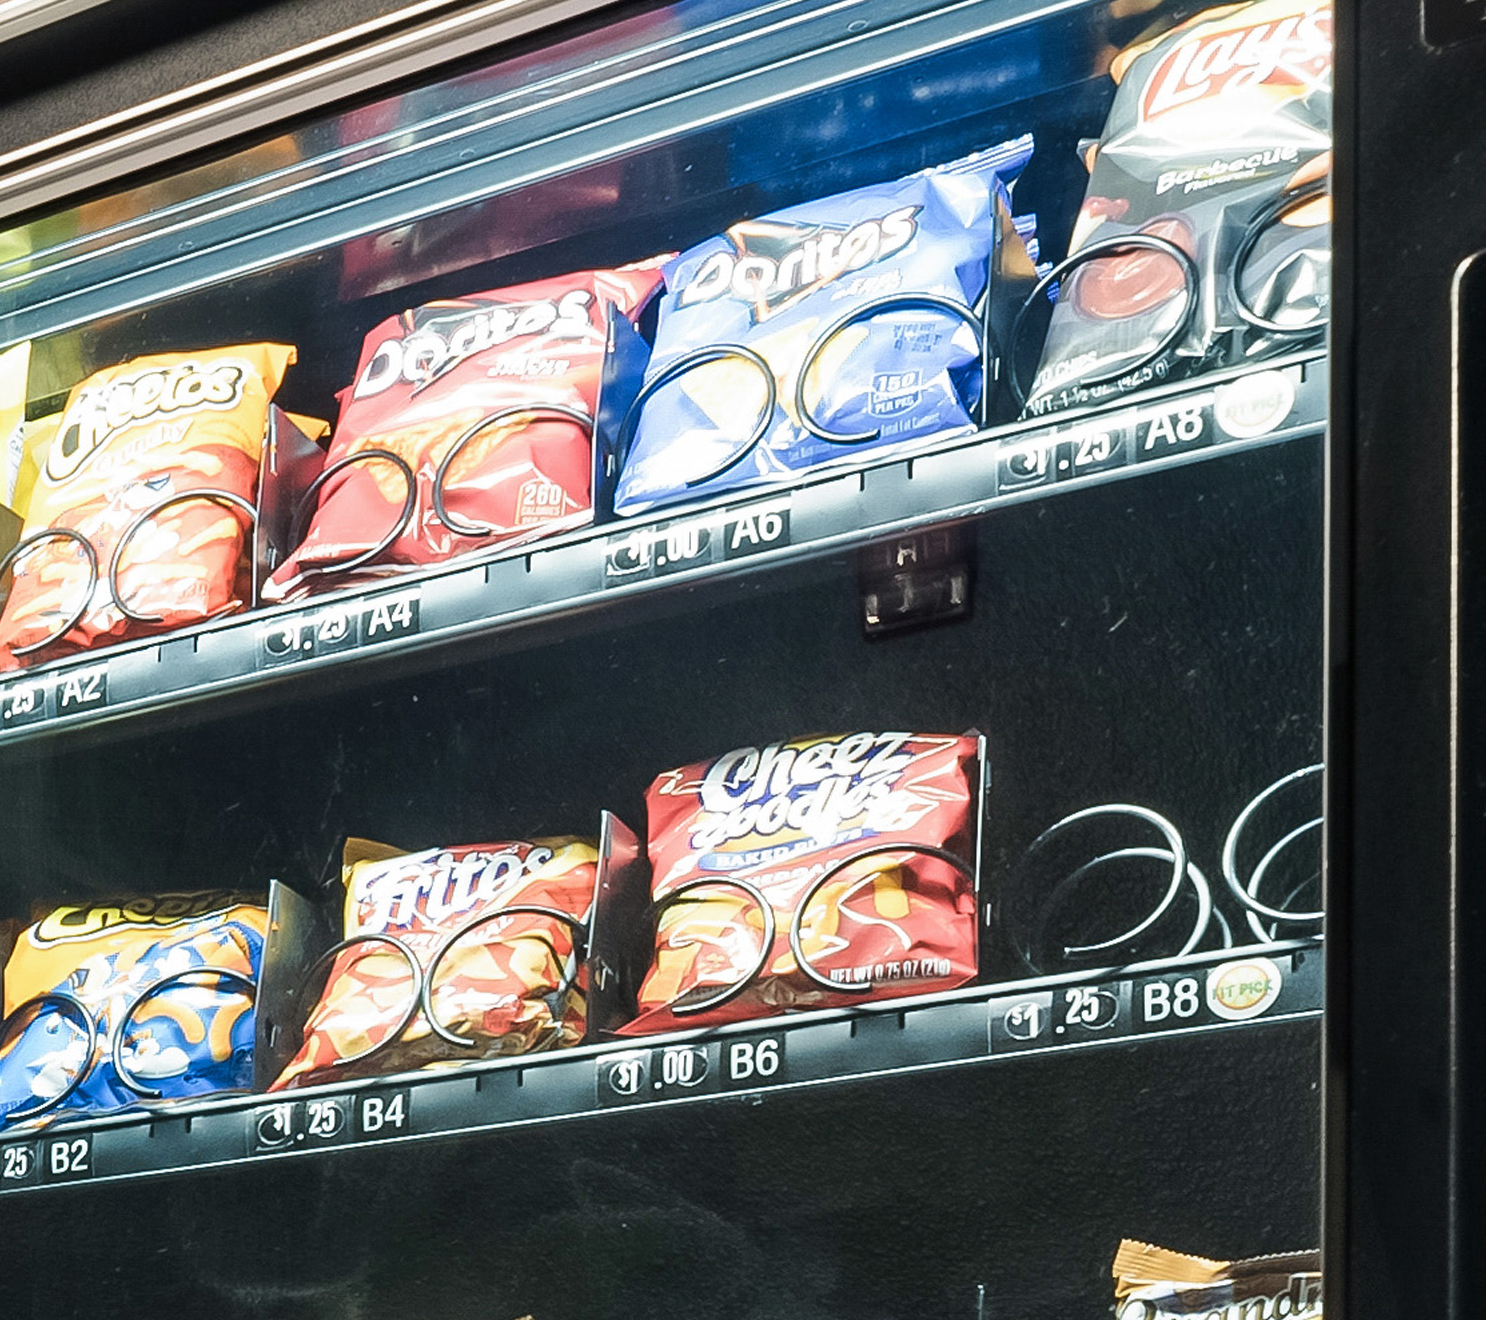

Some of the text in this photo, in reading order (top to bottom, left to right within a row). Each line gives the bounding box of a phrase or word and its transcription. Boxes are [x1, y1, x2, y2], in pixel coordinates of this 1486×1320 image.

[1156, 146, 1298, 195] Barbecue
[677, 206, 923, 309] Doritos
[353, 289, 595, 400] Doritos
[48, 358, 244, 482] Cheetos
[1145, 405, 1204, 451] A8
[731, 512, 784, 548] A6
[368, 600, 413, 636] A4
[61, 673, 103, 707] A2
[701, 731, 914, 812] Cheez
[715, 846, 795, 869] BAKED
[358, 847, 553, 933] Fritos
[1143, 978, 1200, 1022] B8
[1240, 979, 1273, 996] PICK
[731, 1039, 780, 1080] B6
[363, 1096, 405, 1132] B4
[51, 1141, 88, 1174] B2
